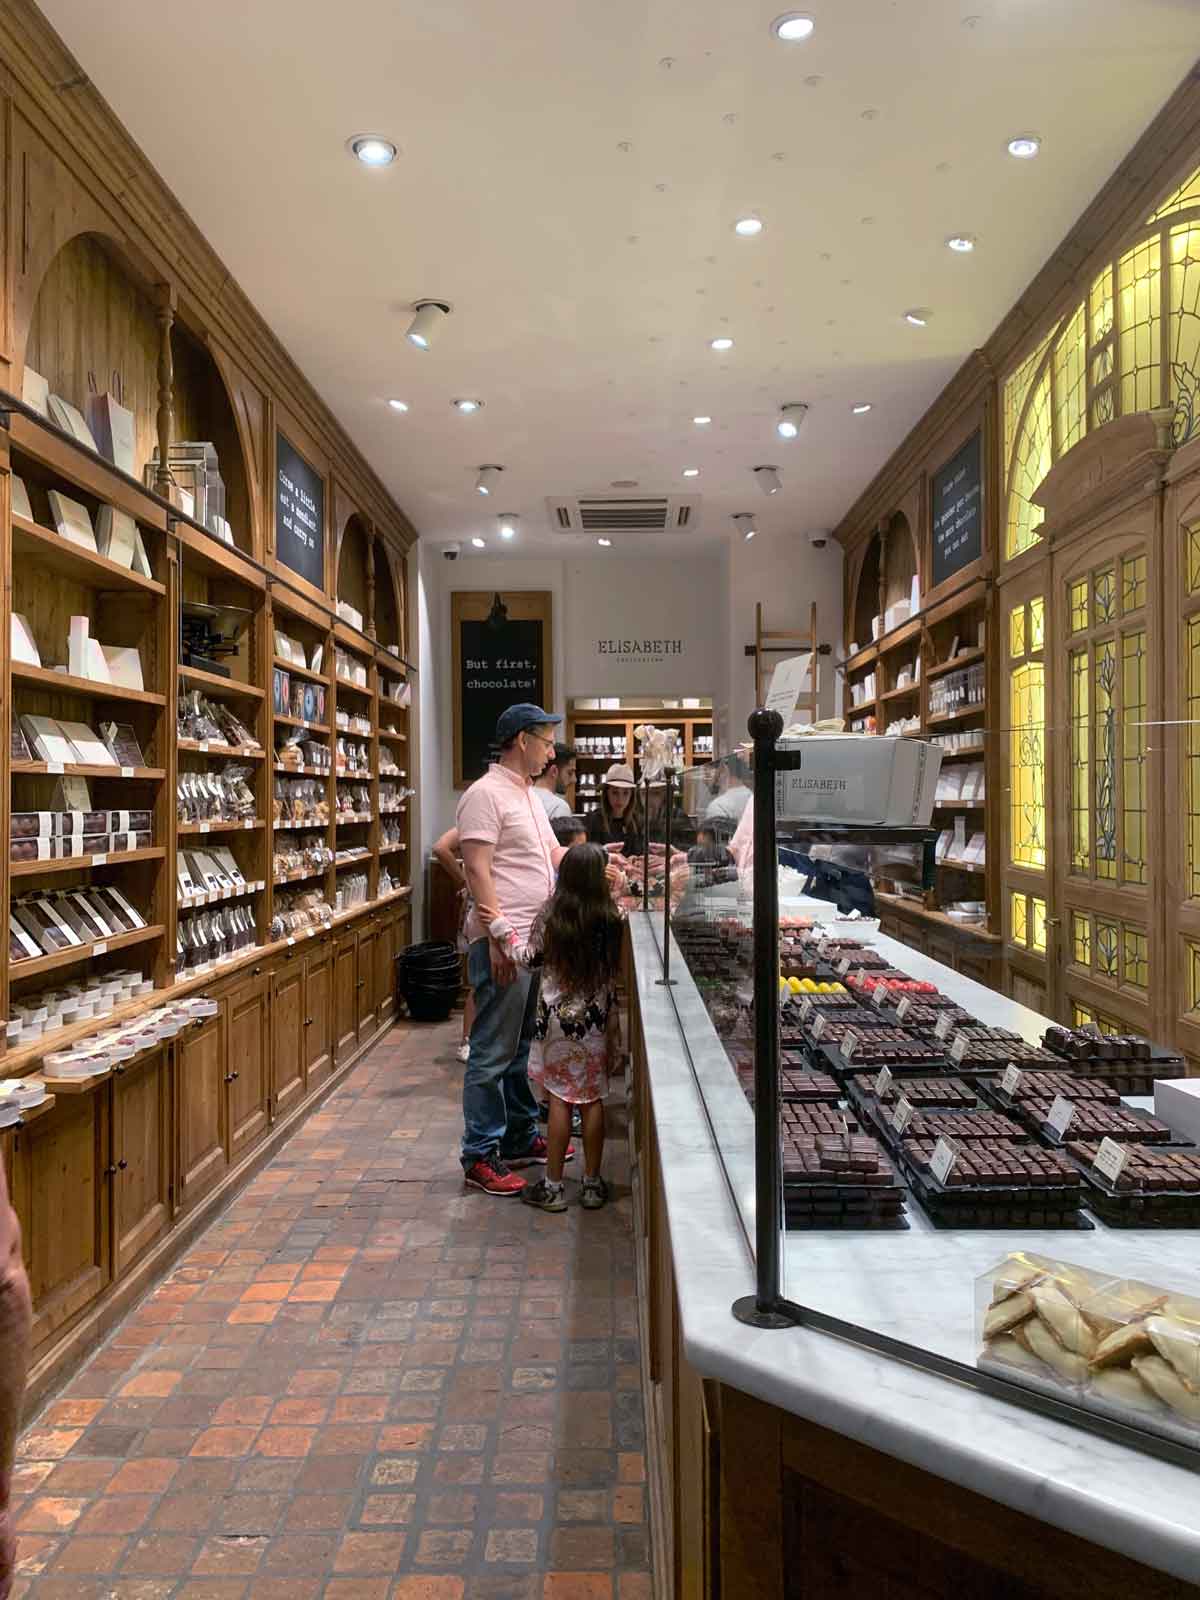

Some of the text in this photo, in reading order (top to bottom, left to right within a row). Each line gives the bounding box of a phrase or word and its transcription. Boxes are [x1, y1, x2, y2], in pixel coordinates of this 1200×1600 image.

[598, 639, 682, 654] ELISABETH
[466, 659, 537, 671] But first,
[466, 678, 536, 689] chocolate!
[792, 777, 847, 791] ELISABETH
